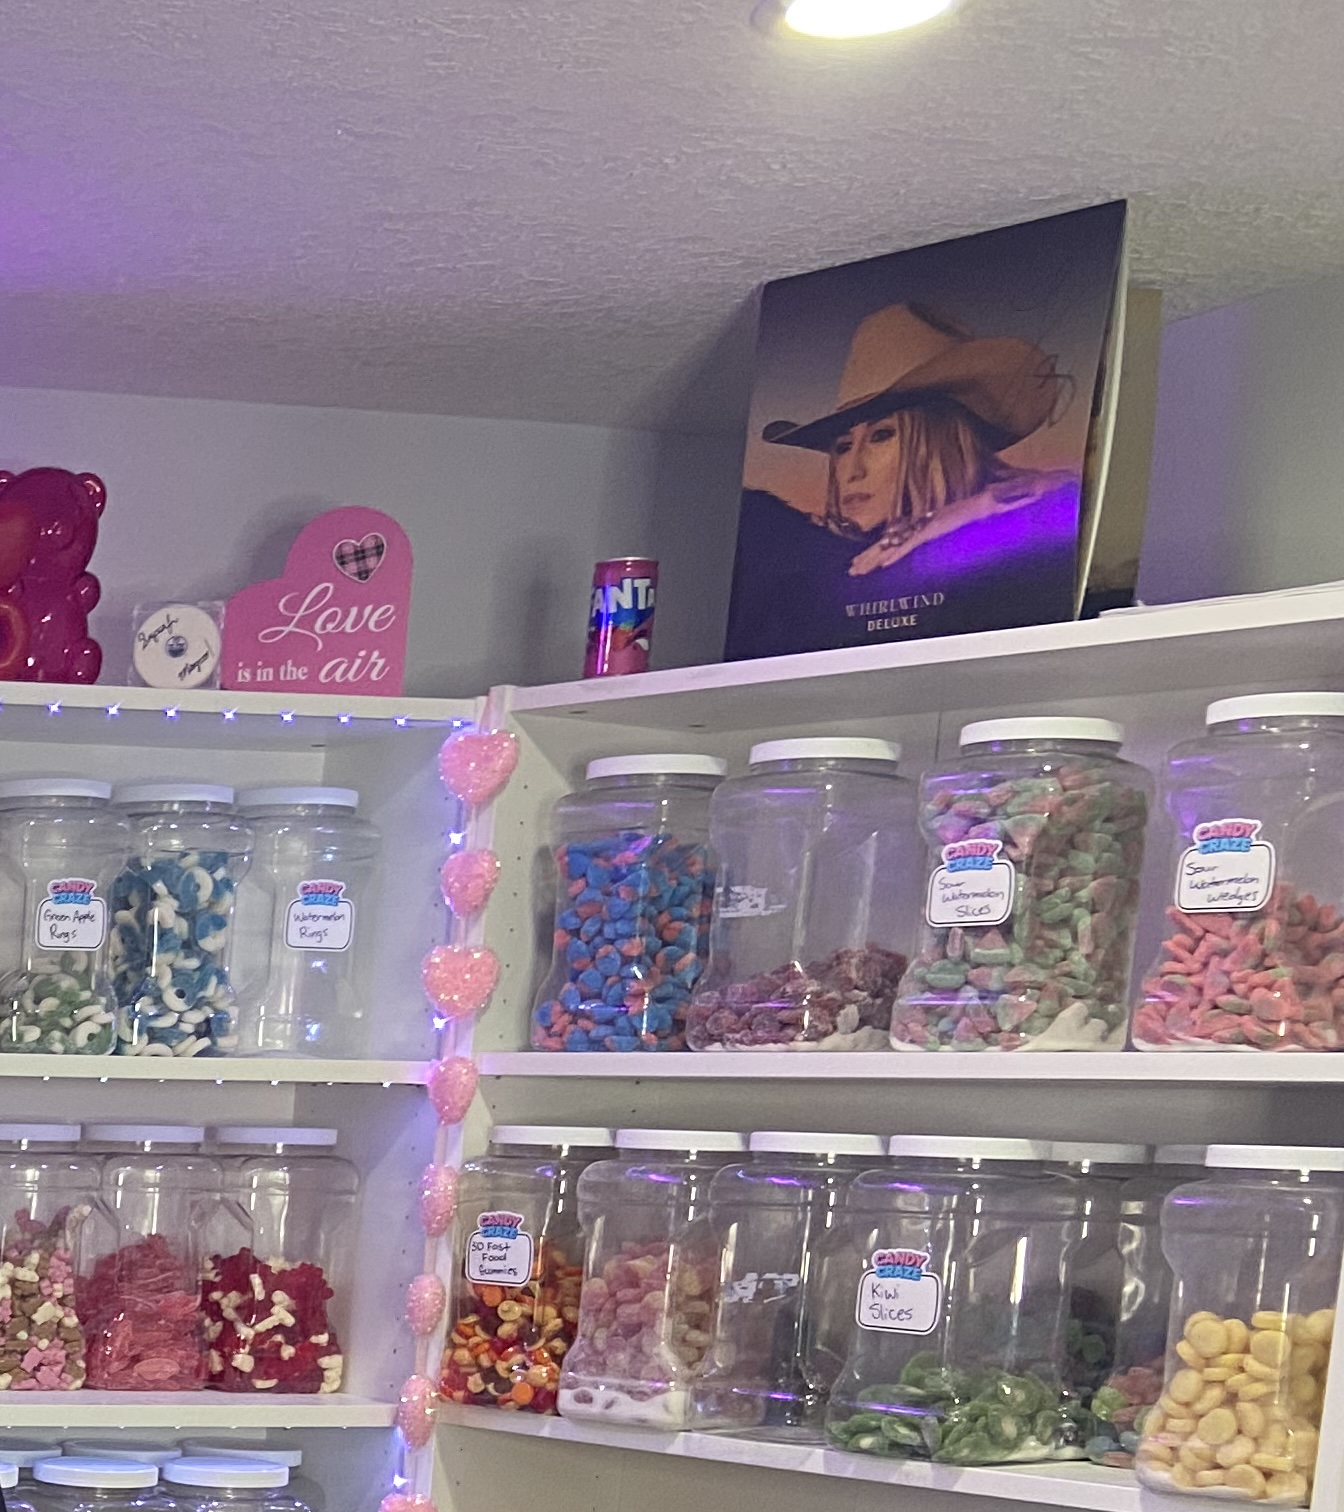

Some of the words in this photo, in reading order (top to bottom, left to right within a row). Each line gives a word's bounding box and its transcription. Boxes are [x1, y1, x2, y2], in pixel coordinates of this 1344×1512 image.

[845, 592, 944, 618] WHIRLWIND
[258, 583, 395, 651] Love
[867, 615, 917, 632] DELUXE
[238, 662, 250, 683] is
[254, 662, 274, 683] in
[278, 661, 308, 683] the
[318, 651, 390, 684] air
[481, 1252, 507, 1263] Food
[873, 1251, 929, 1269] CANDY
[876, 1265, 923, 1281] CRAZE
[871, 1281, 900, 1301] Kiwi
[869, 1302, 913, 1322] Slices
